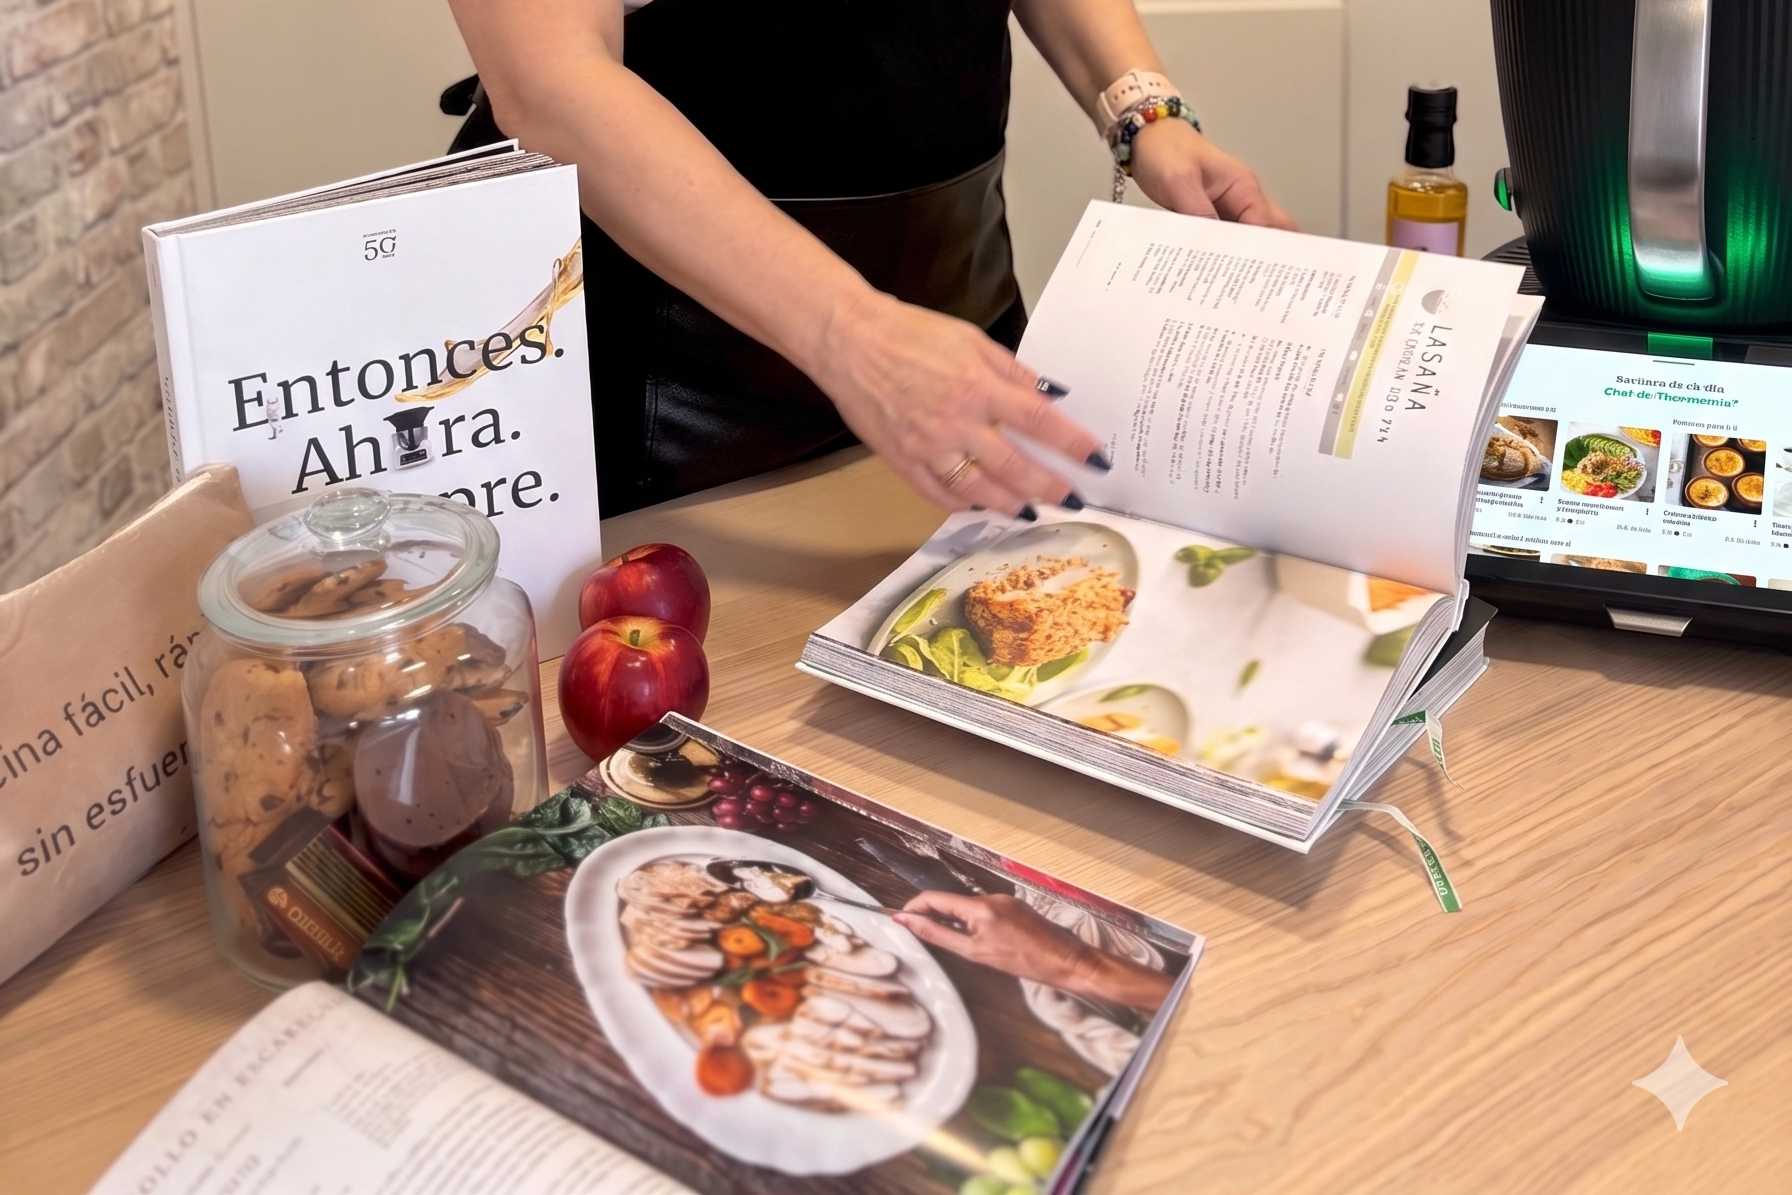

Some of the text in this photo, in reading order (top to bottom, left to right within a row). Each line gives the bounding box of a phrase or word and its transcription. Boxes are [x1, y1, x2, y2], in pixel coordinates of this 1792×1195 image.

[228, 323, 565, 432] Entonces.
[291, 404, 521, 495] Ahra.
[63, 666, 155, 737] fácil,
[17, 823, 76, 877] sin
